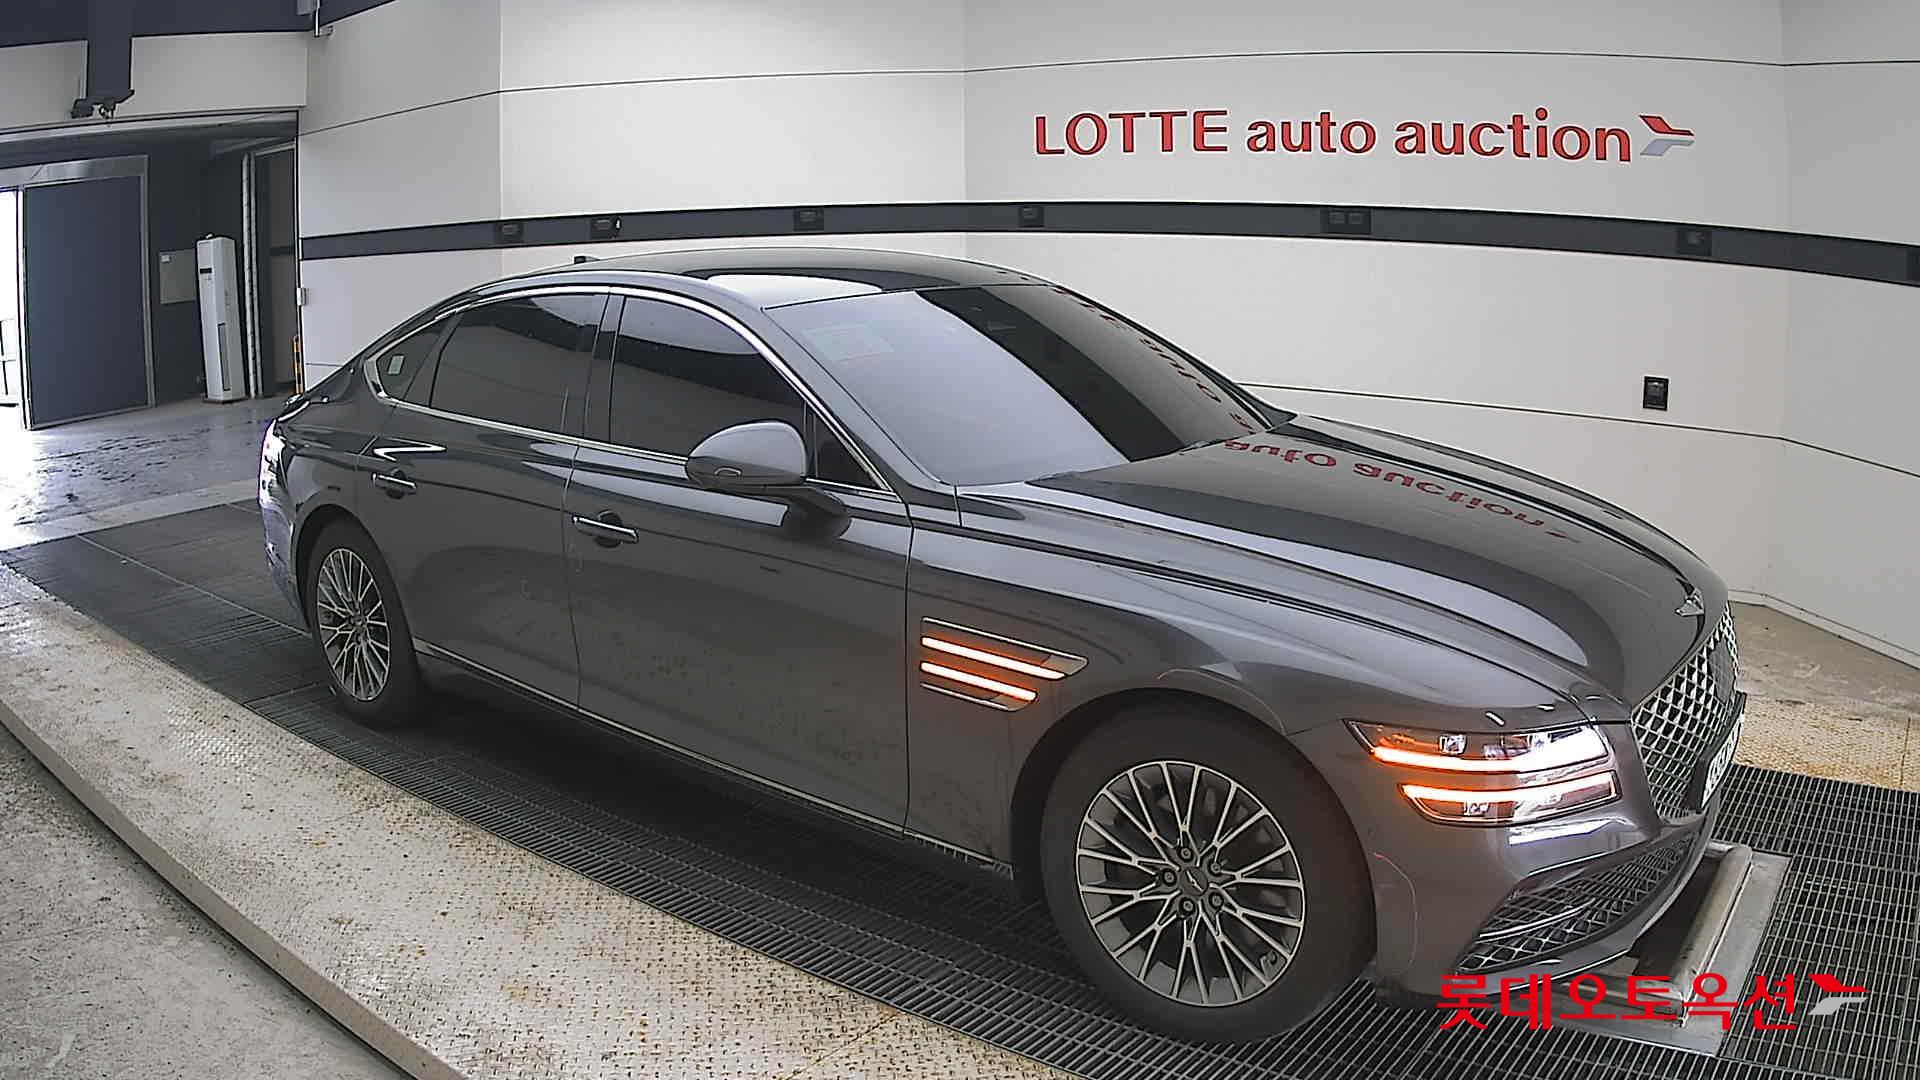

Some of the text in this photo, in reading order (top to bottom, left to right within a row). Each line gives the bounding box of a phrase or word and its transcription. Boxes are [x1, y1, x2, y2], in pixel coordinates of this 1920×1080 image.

[1035, 107, 1631, 162] LOTTE auto auction
